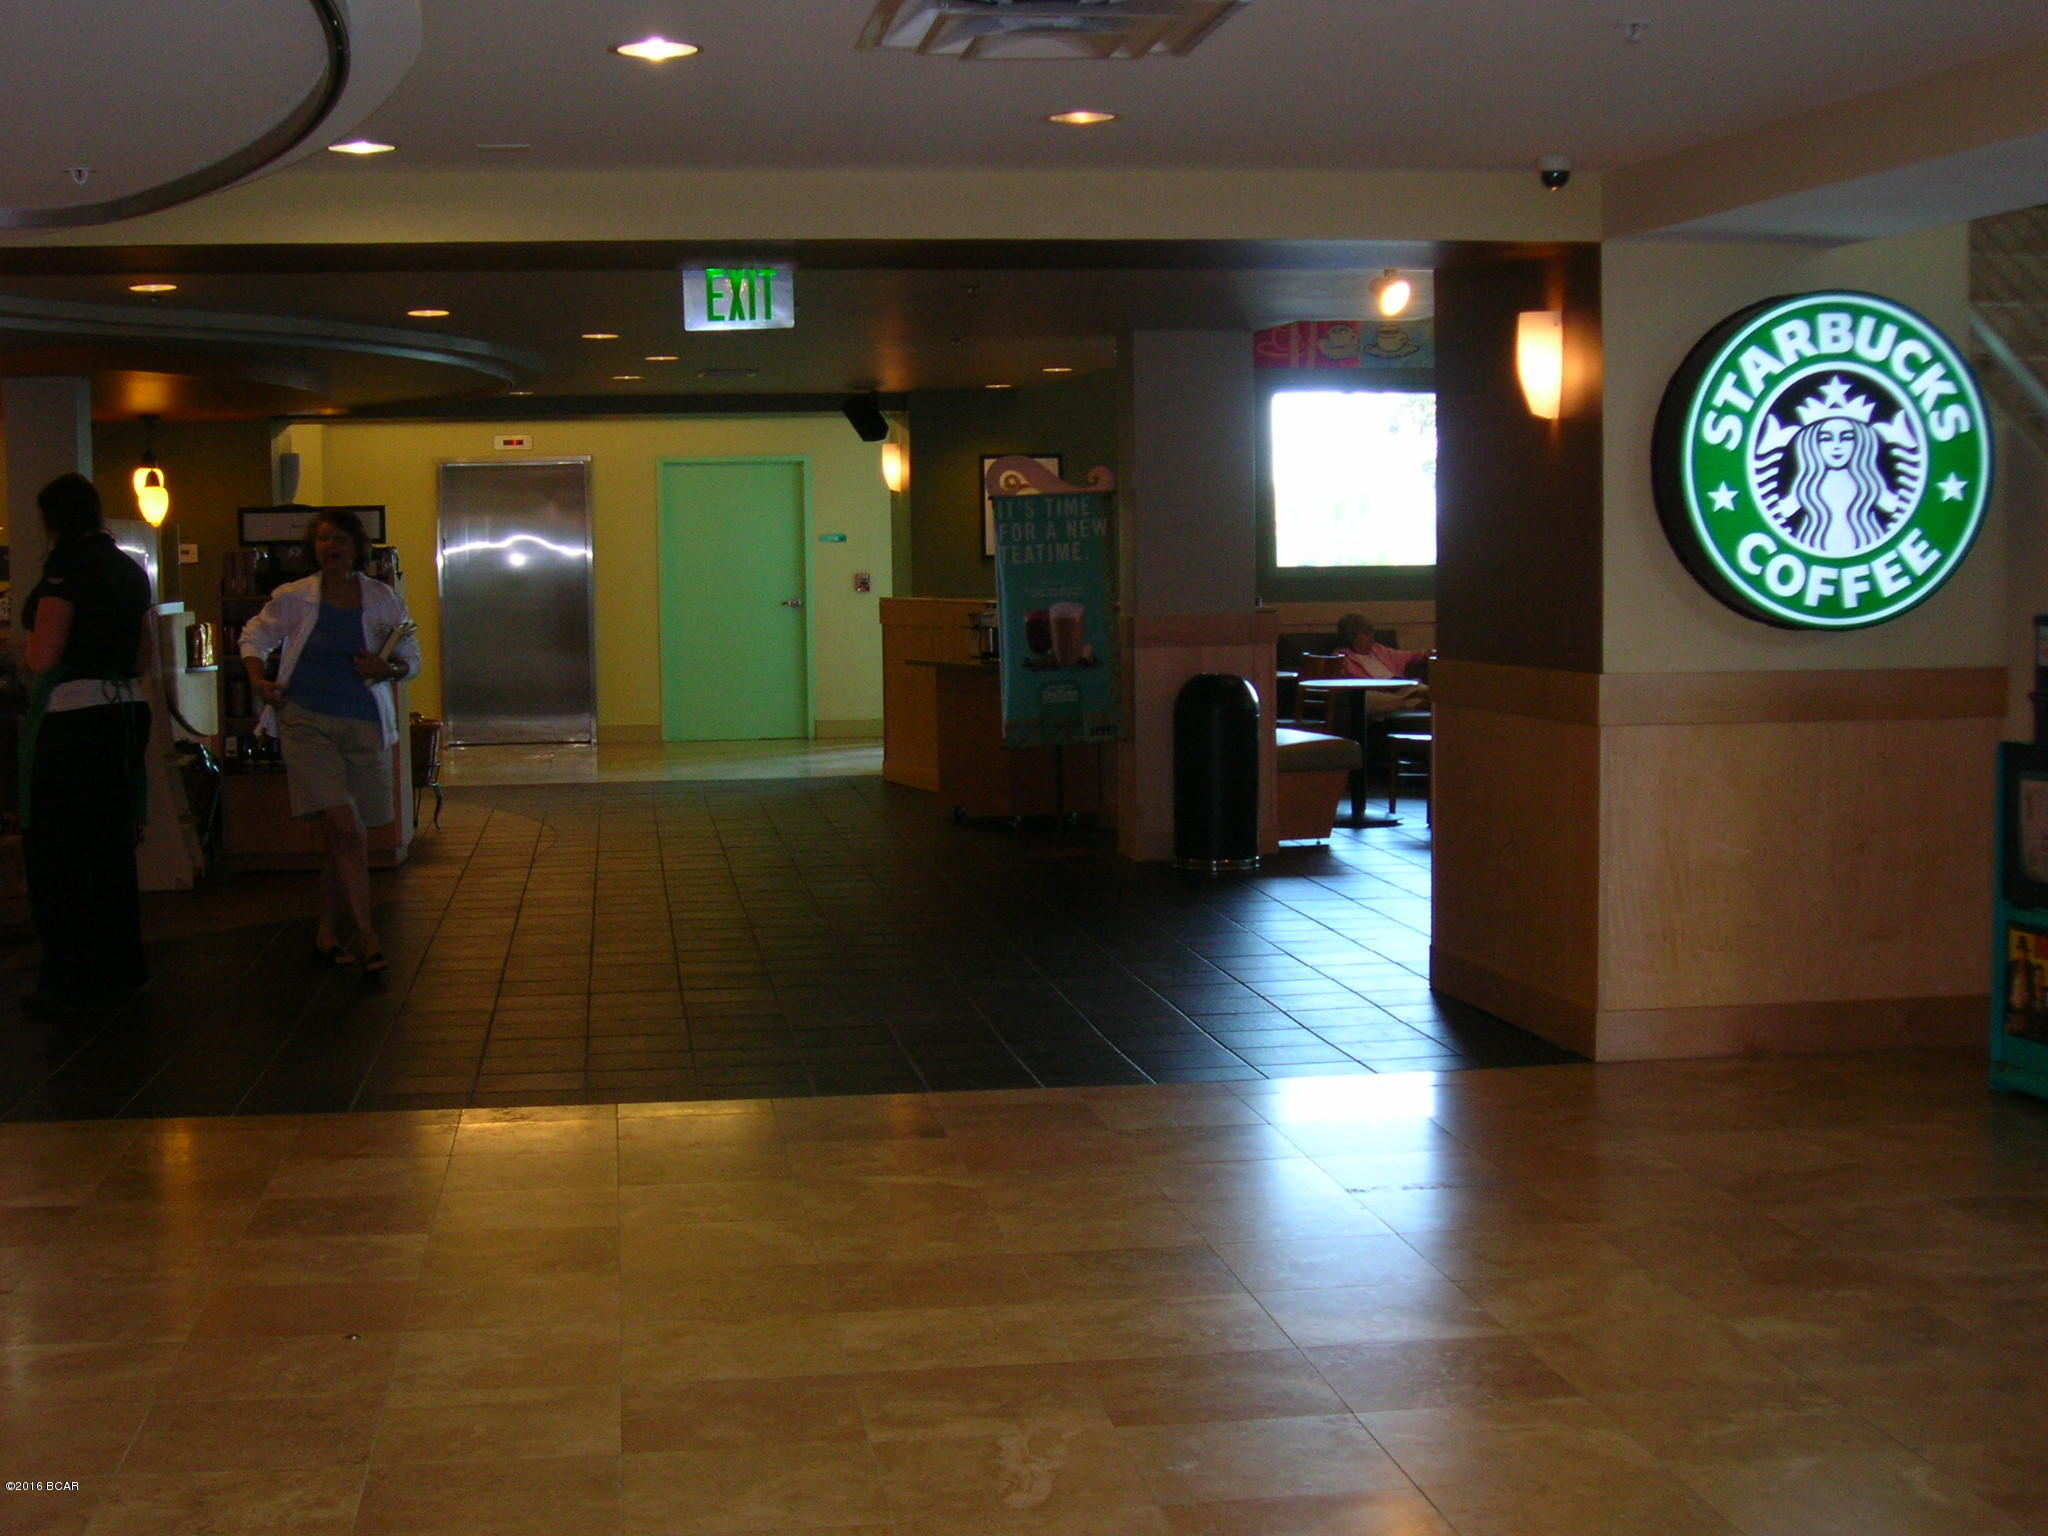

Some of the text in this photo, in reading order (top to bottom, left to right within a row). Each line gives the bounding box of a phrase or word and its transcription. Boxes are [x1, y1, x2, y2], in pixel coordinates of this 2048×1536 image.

[706, 268, 777, 321] EXIT
[1700, 311, 1972, 452] STARBUCKS
[998, 497, 1091, 520] IT'S TIME
[998, 518, 1108, 542] FOR A NEW
[998, 542, 1090, 564] TEATIME.
[1735, 528, 1942, 610] COFFEE
